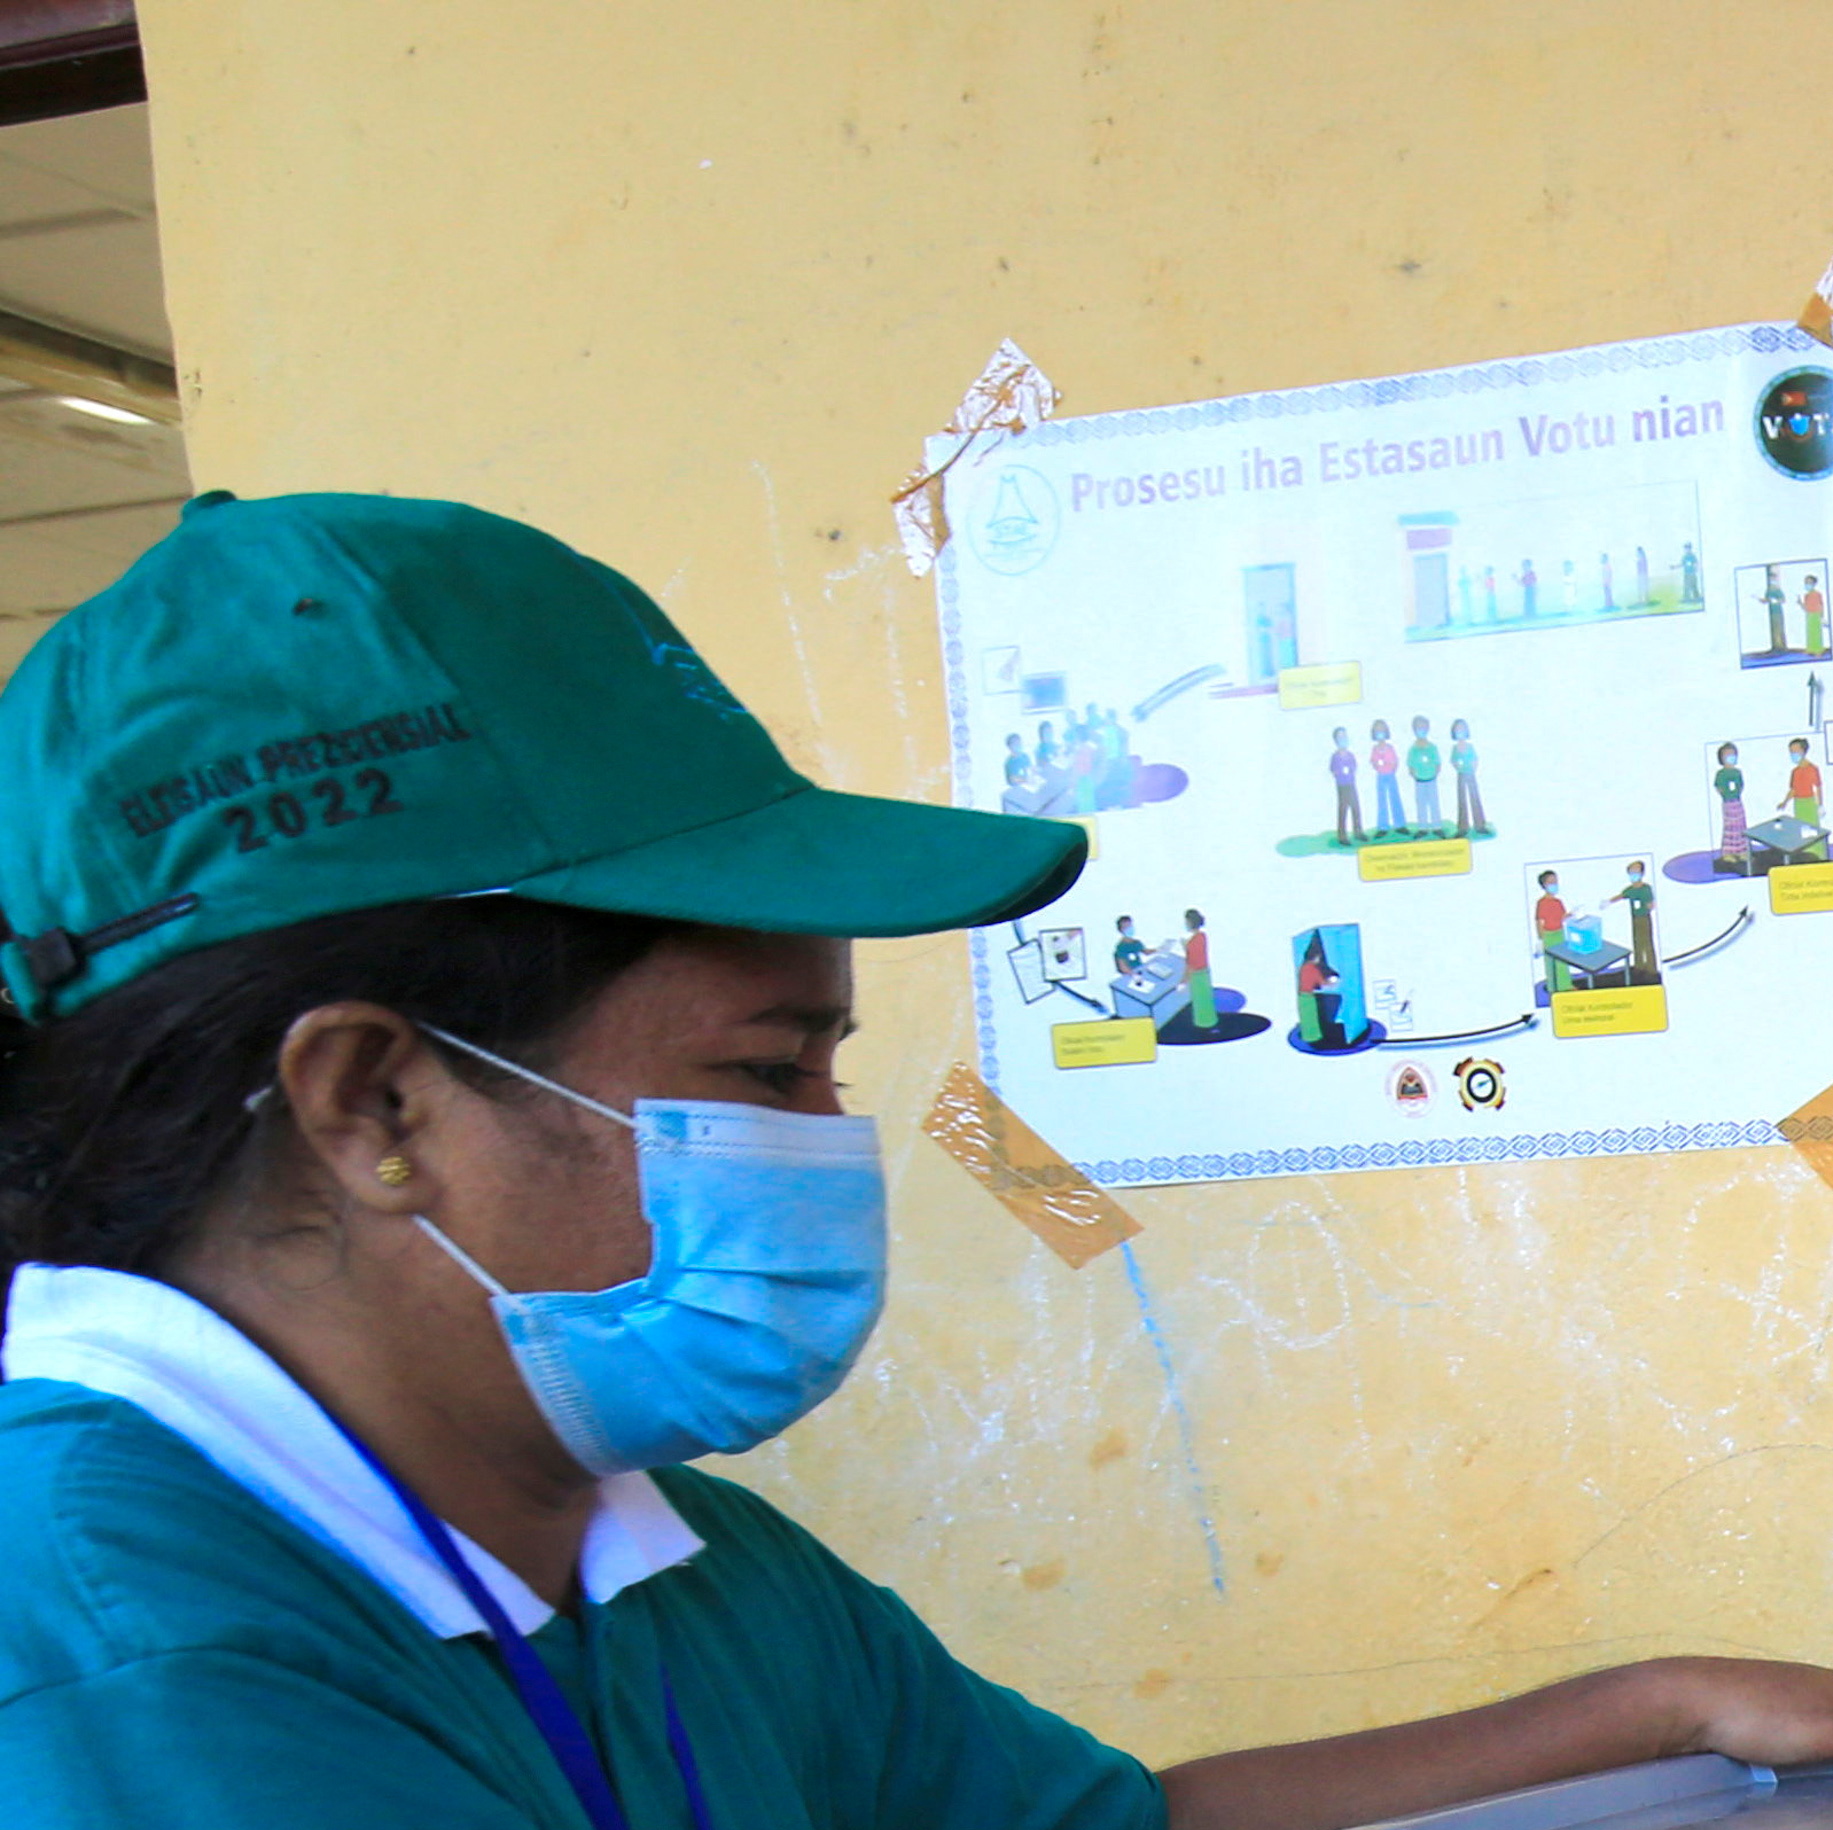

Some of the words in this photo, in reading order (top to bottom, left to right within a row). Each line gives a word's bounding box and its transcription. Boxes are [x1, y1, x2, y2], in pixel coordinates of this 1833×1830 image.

[1070, 465, 1226, 513] Prosesu
[1240, 447, 1304, 492] iha
[1319, 429, 1505, 483] Estasaun
[1517, 412, 1616, 459] Votu
[1632, 394, 1725, 443] nian
[222, 767, 403, 853] 2022
